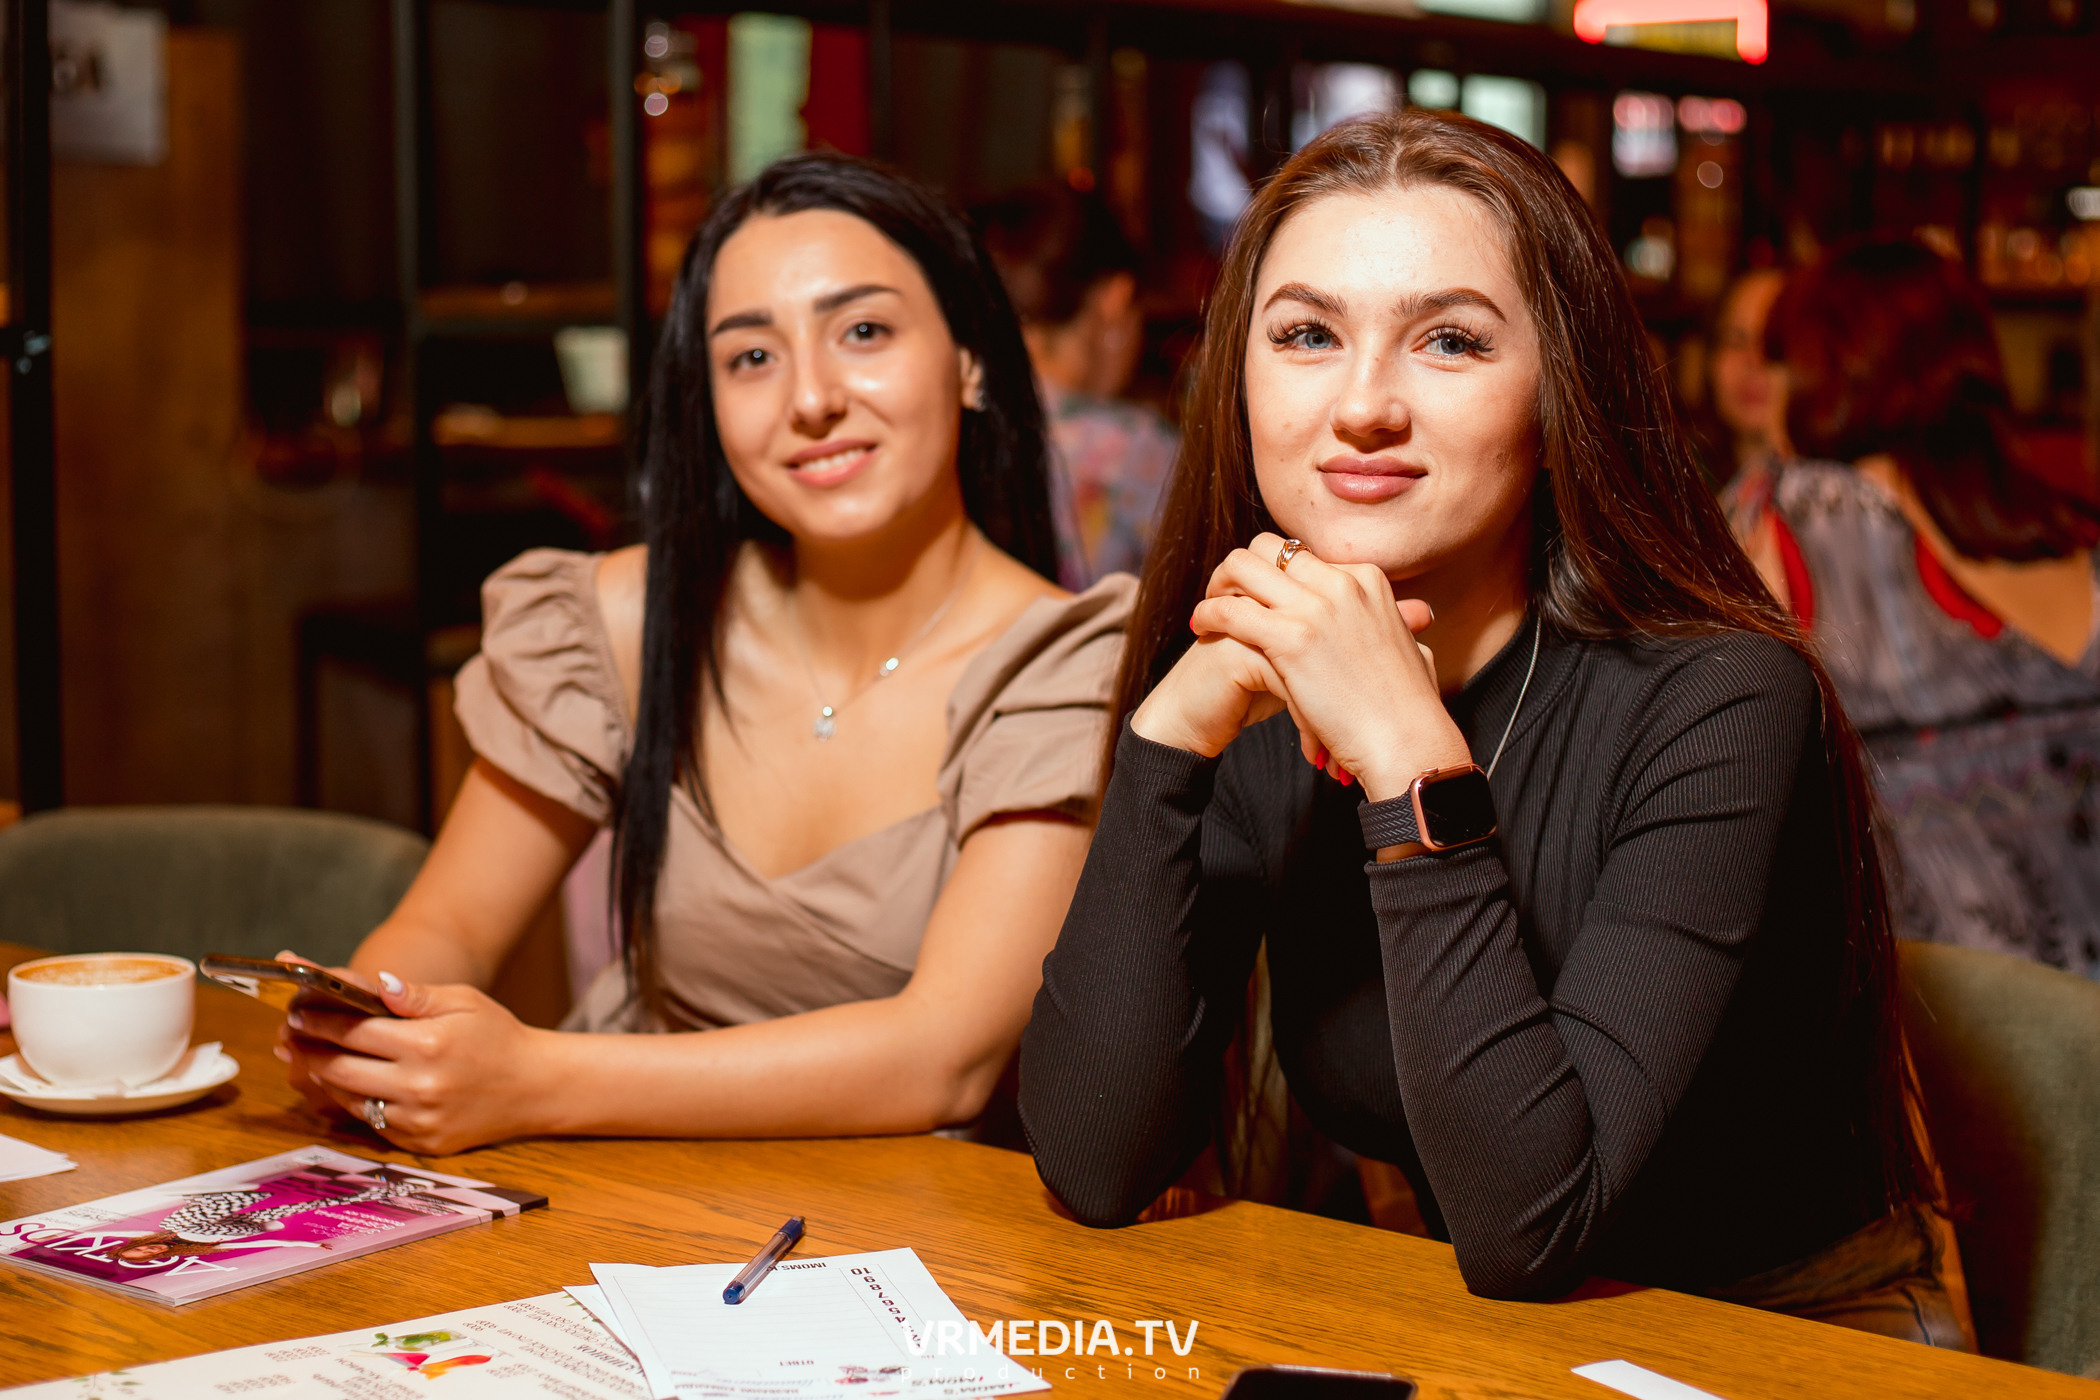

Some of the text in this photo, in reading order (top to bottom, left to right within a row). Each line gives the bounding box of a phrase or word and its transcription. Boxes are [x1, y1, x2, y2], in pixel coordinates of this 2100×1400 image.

[851, 1267, 872, 1276] 10
[863, 1275, 876, 1283] 9
[869, 1283, 883, 1291] 8
[888, 1307, 901, 1315] 5
